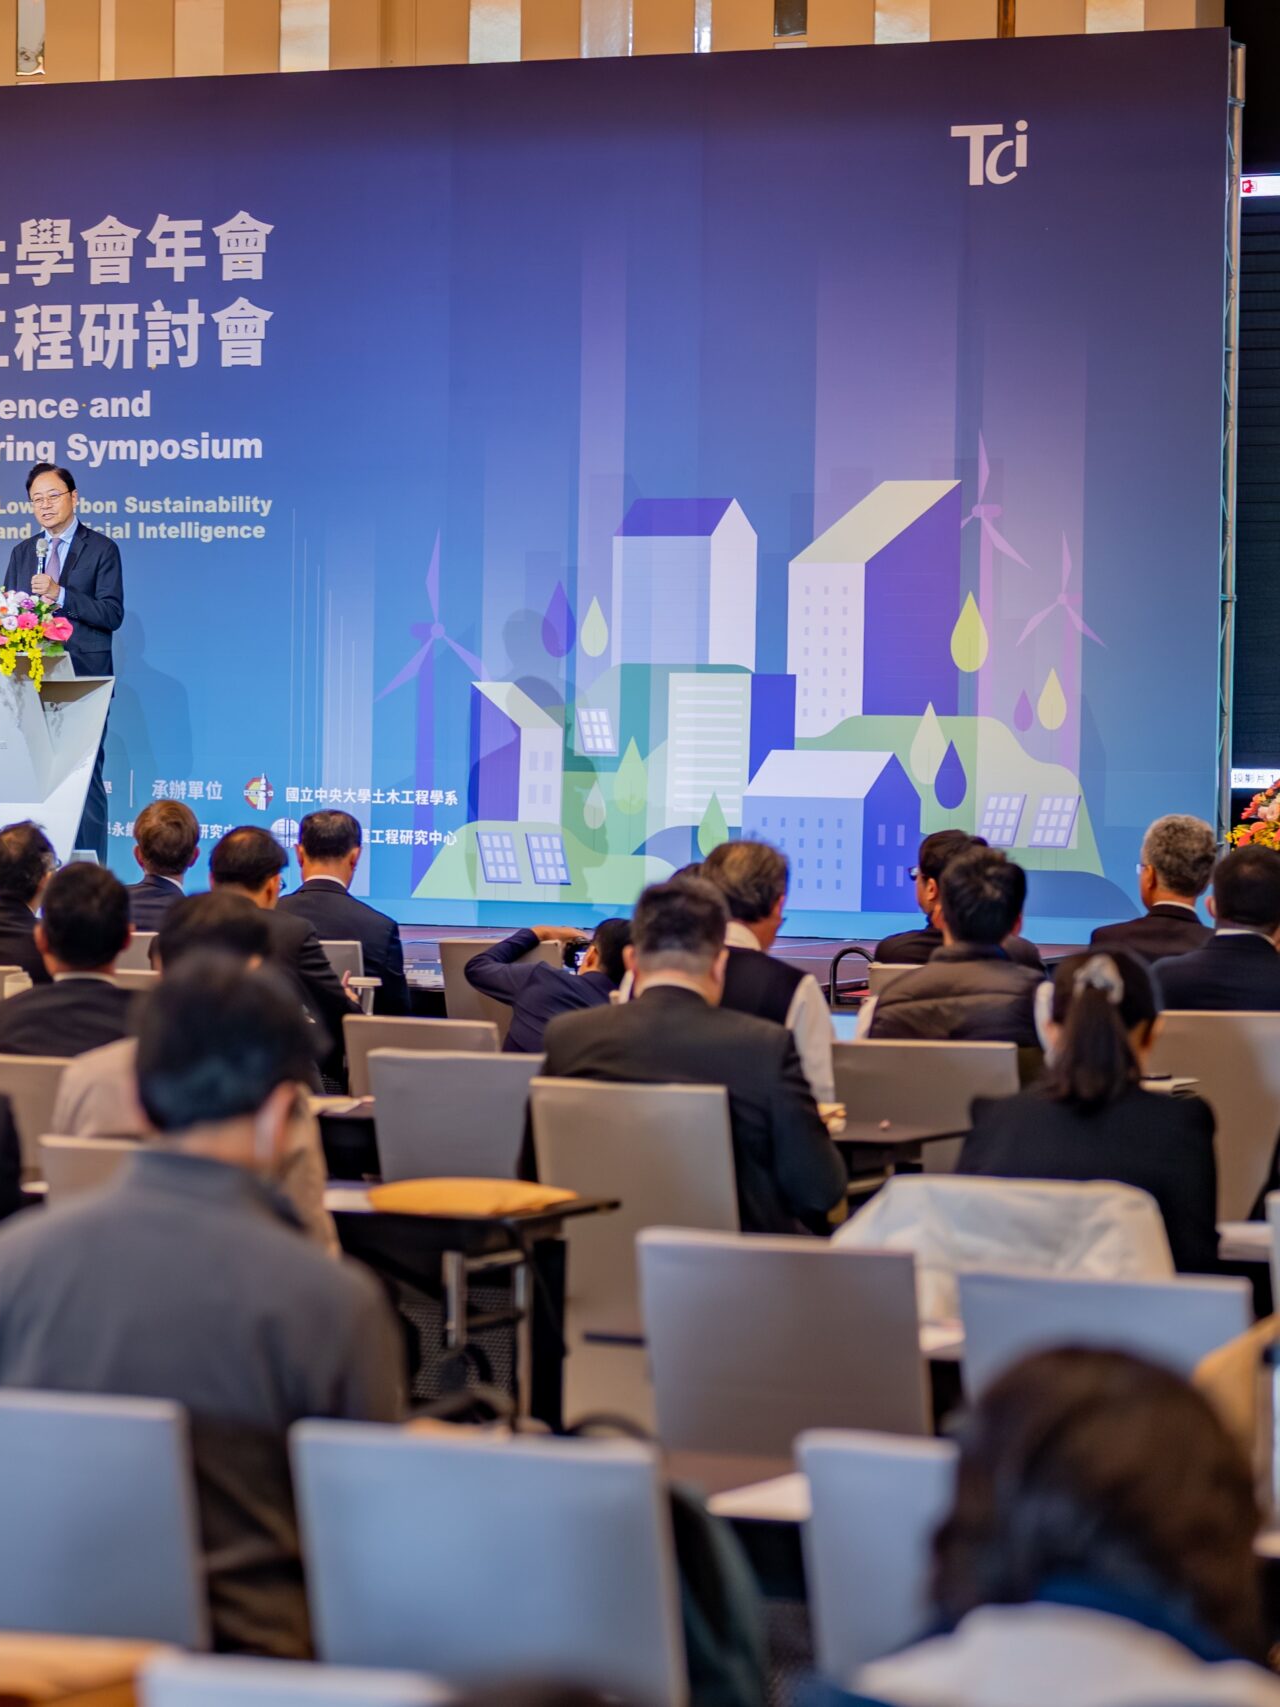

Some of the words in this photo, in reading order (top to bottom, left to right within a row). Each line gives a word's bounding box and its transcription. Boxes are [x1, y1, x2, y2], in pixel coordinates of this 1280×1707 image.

[89, 390, 151, 418] and
[67, 432, 263, 468] Symposium
[124, 496, 272, 516] Sustainability
[138, 521, 266, 543] Intelligence
[152, 779, 223, 800] 承辦單位
[286, 787, 458, 806] 國立中央大學土木工程學系
[361, 829, 457, 846] 工程研究中心
